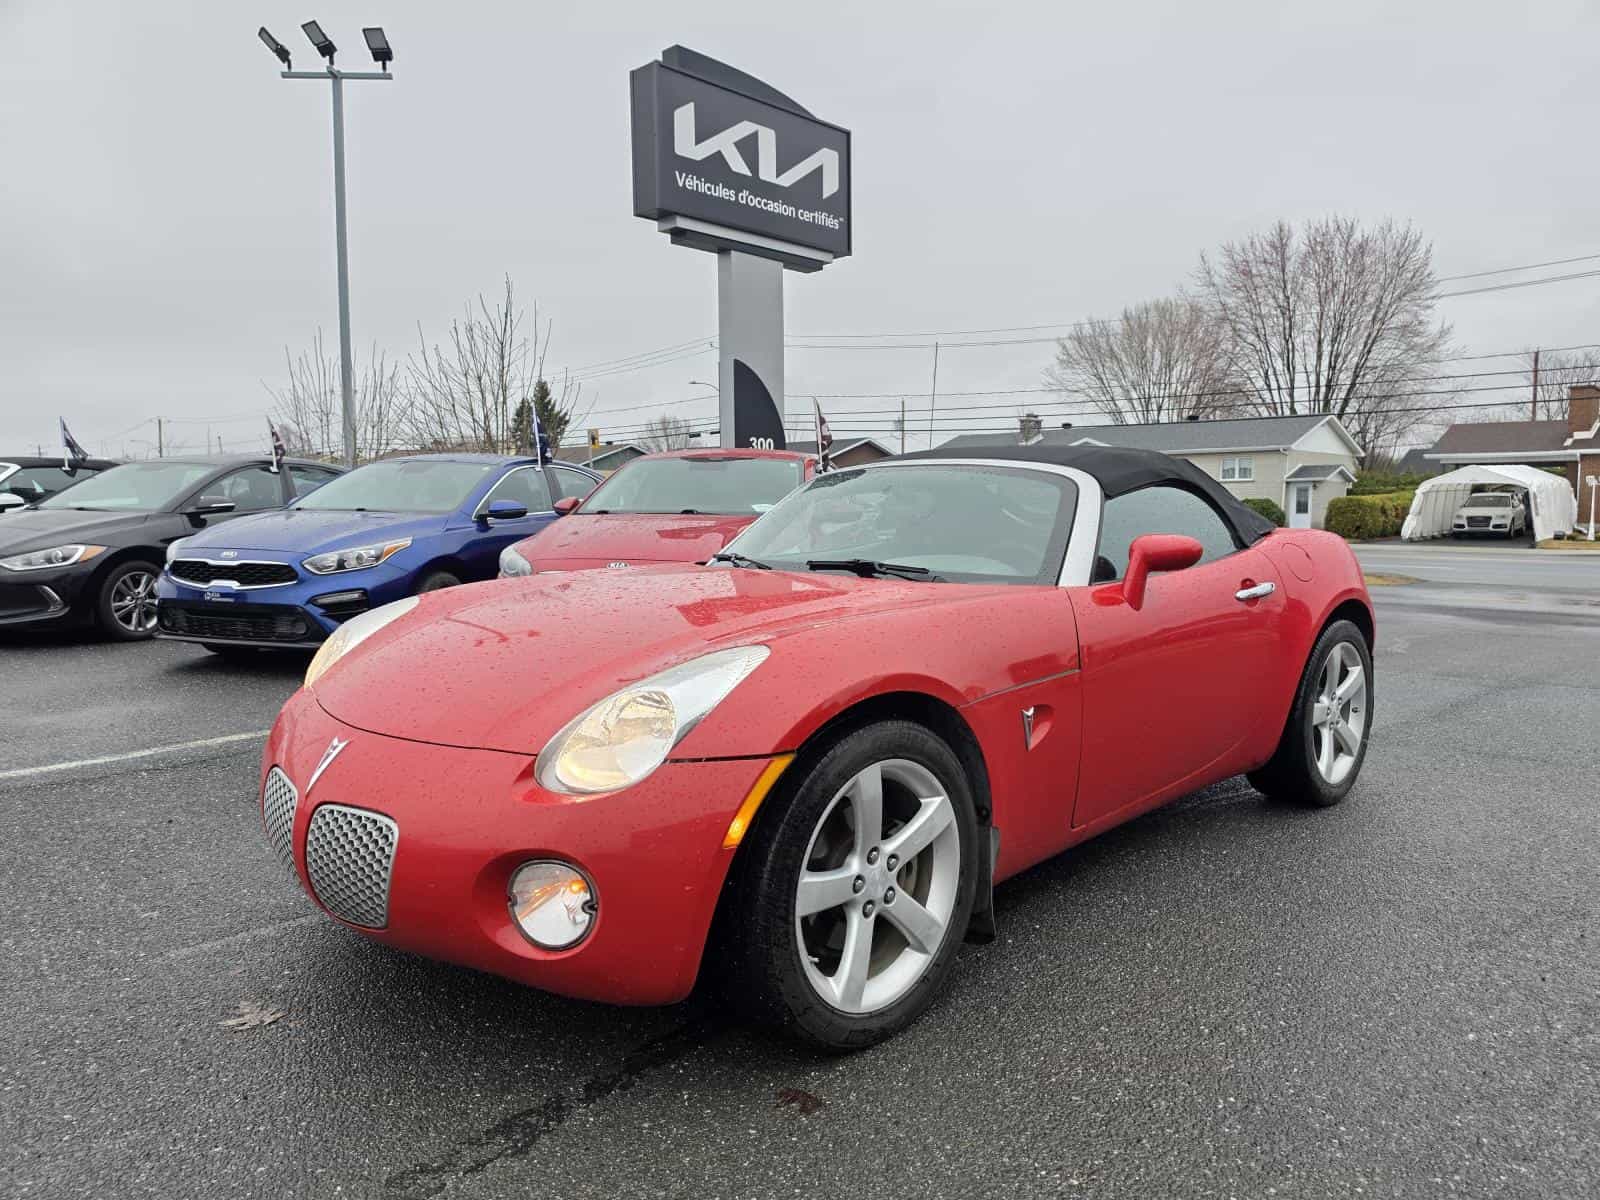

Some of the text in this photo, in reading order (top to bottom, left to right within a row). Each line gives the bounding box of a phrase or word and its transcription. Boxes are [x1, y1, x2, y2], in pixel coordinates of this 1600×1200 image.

[674, 101, 839, 200] KIA
[675, 170, 735, 201] Véhicules
[738, 189, 796, 218] d'occasion
[749, 437, 774, 450] 300
